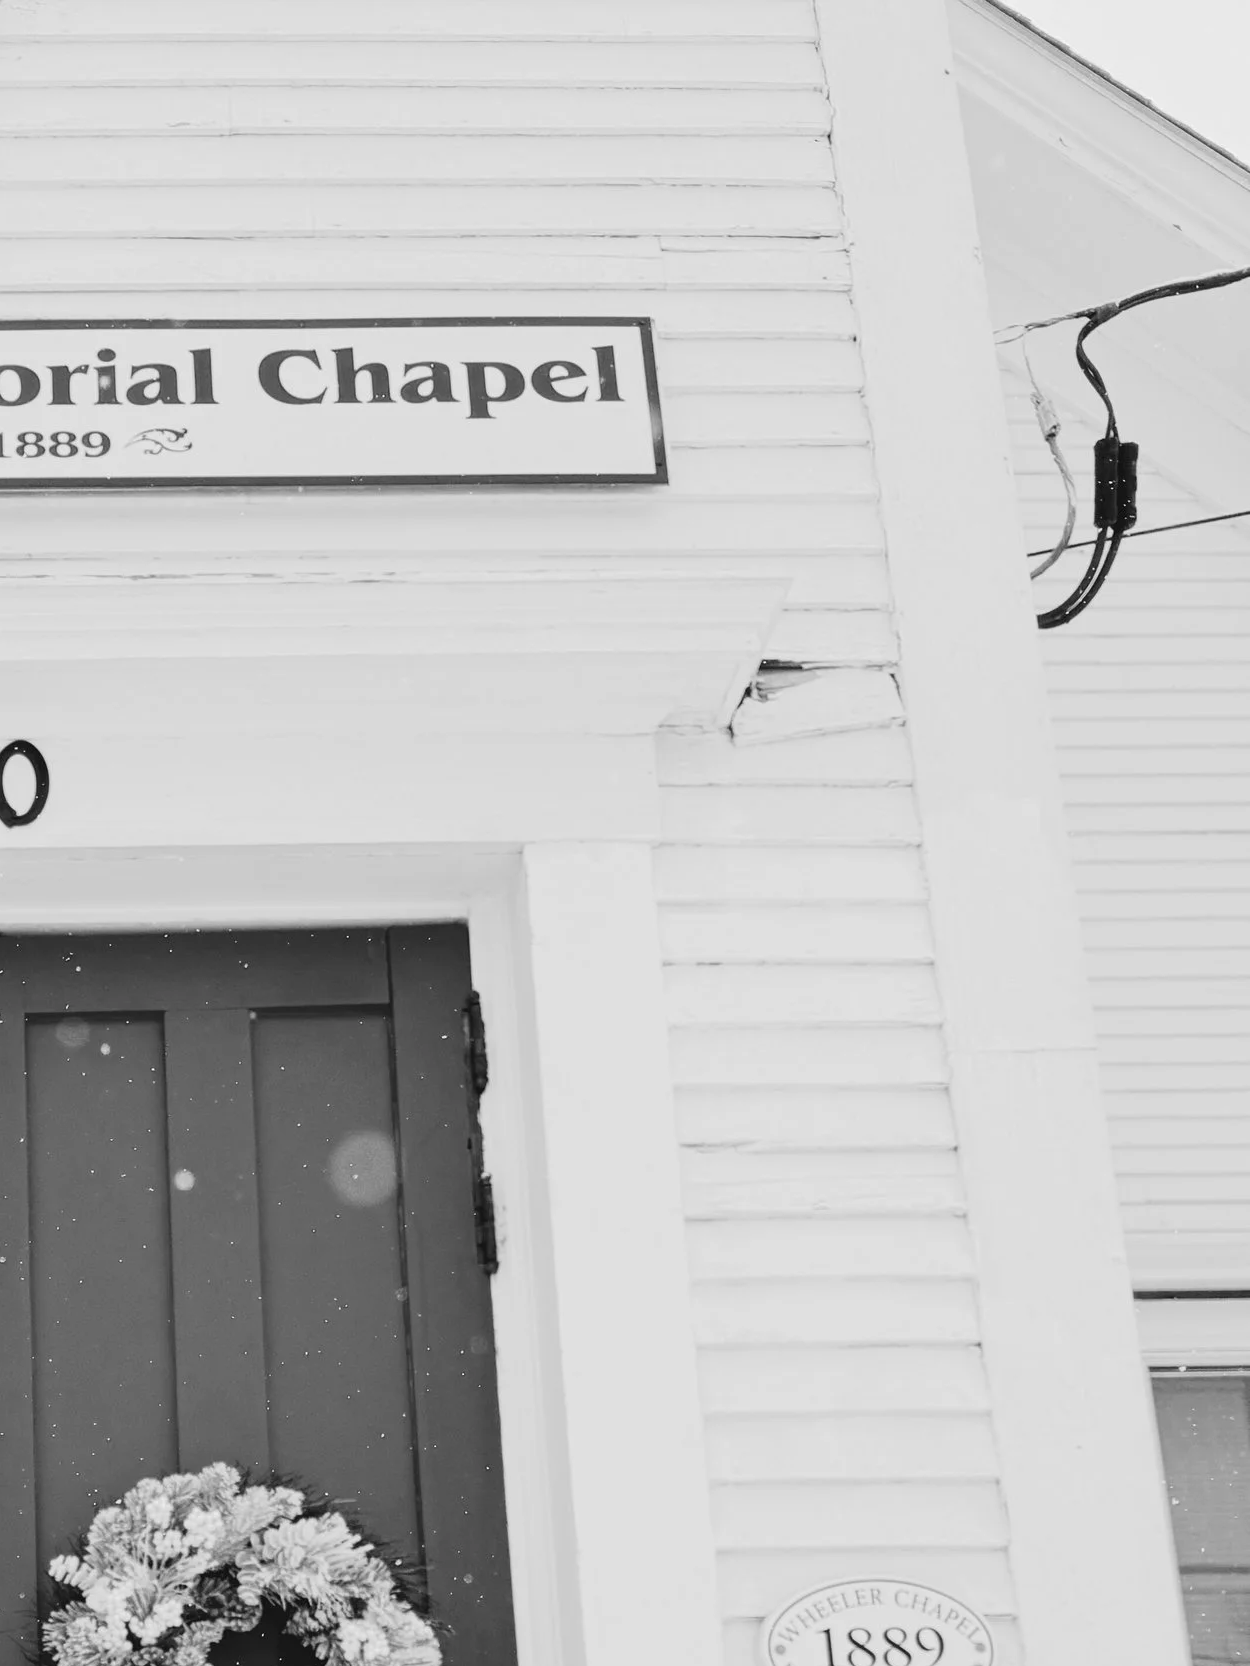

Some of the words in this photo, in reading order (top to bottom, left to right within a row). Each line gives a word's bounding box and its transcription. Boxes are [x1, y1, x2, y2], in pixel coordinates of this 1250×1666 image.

[257, 345, 626, 419] Chapel
[778, 1588, 885, 1643] WHEELER
[894, 1590, 981, 1646] CHAPEL
